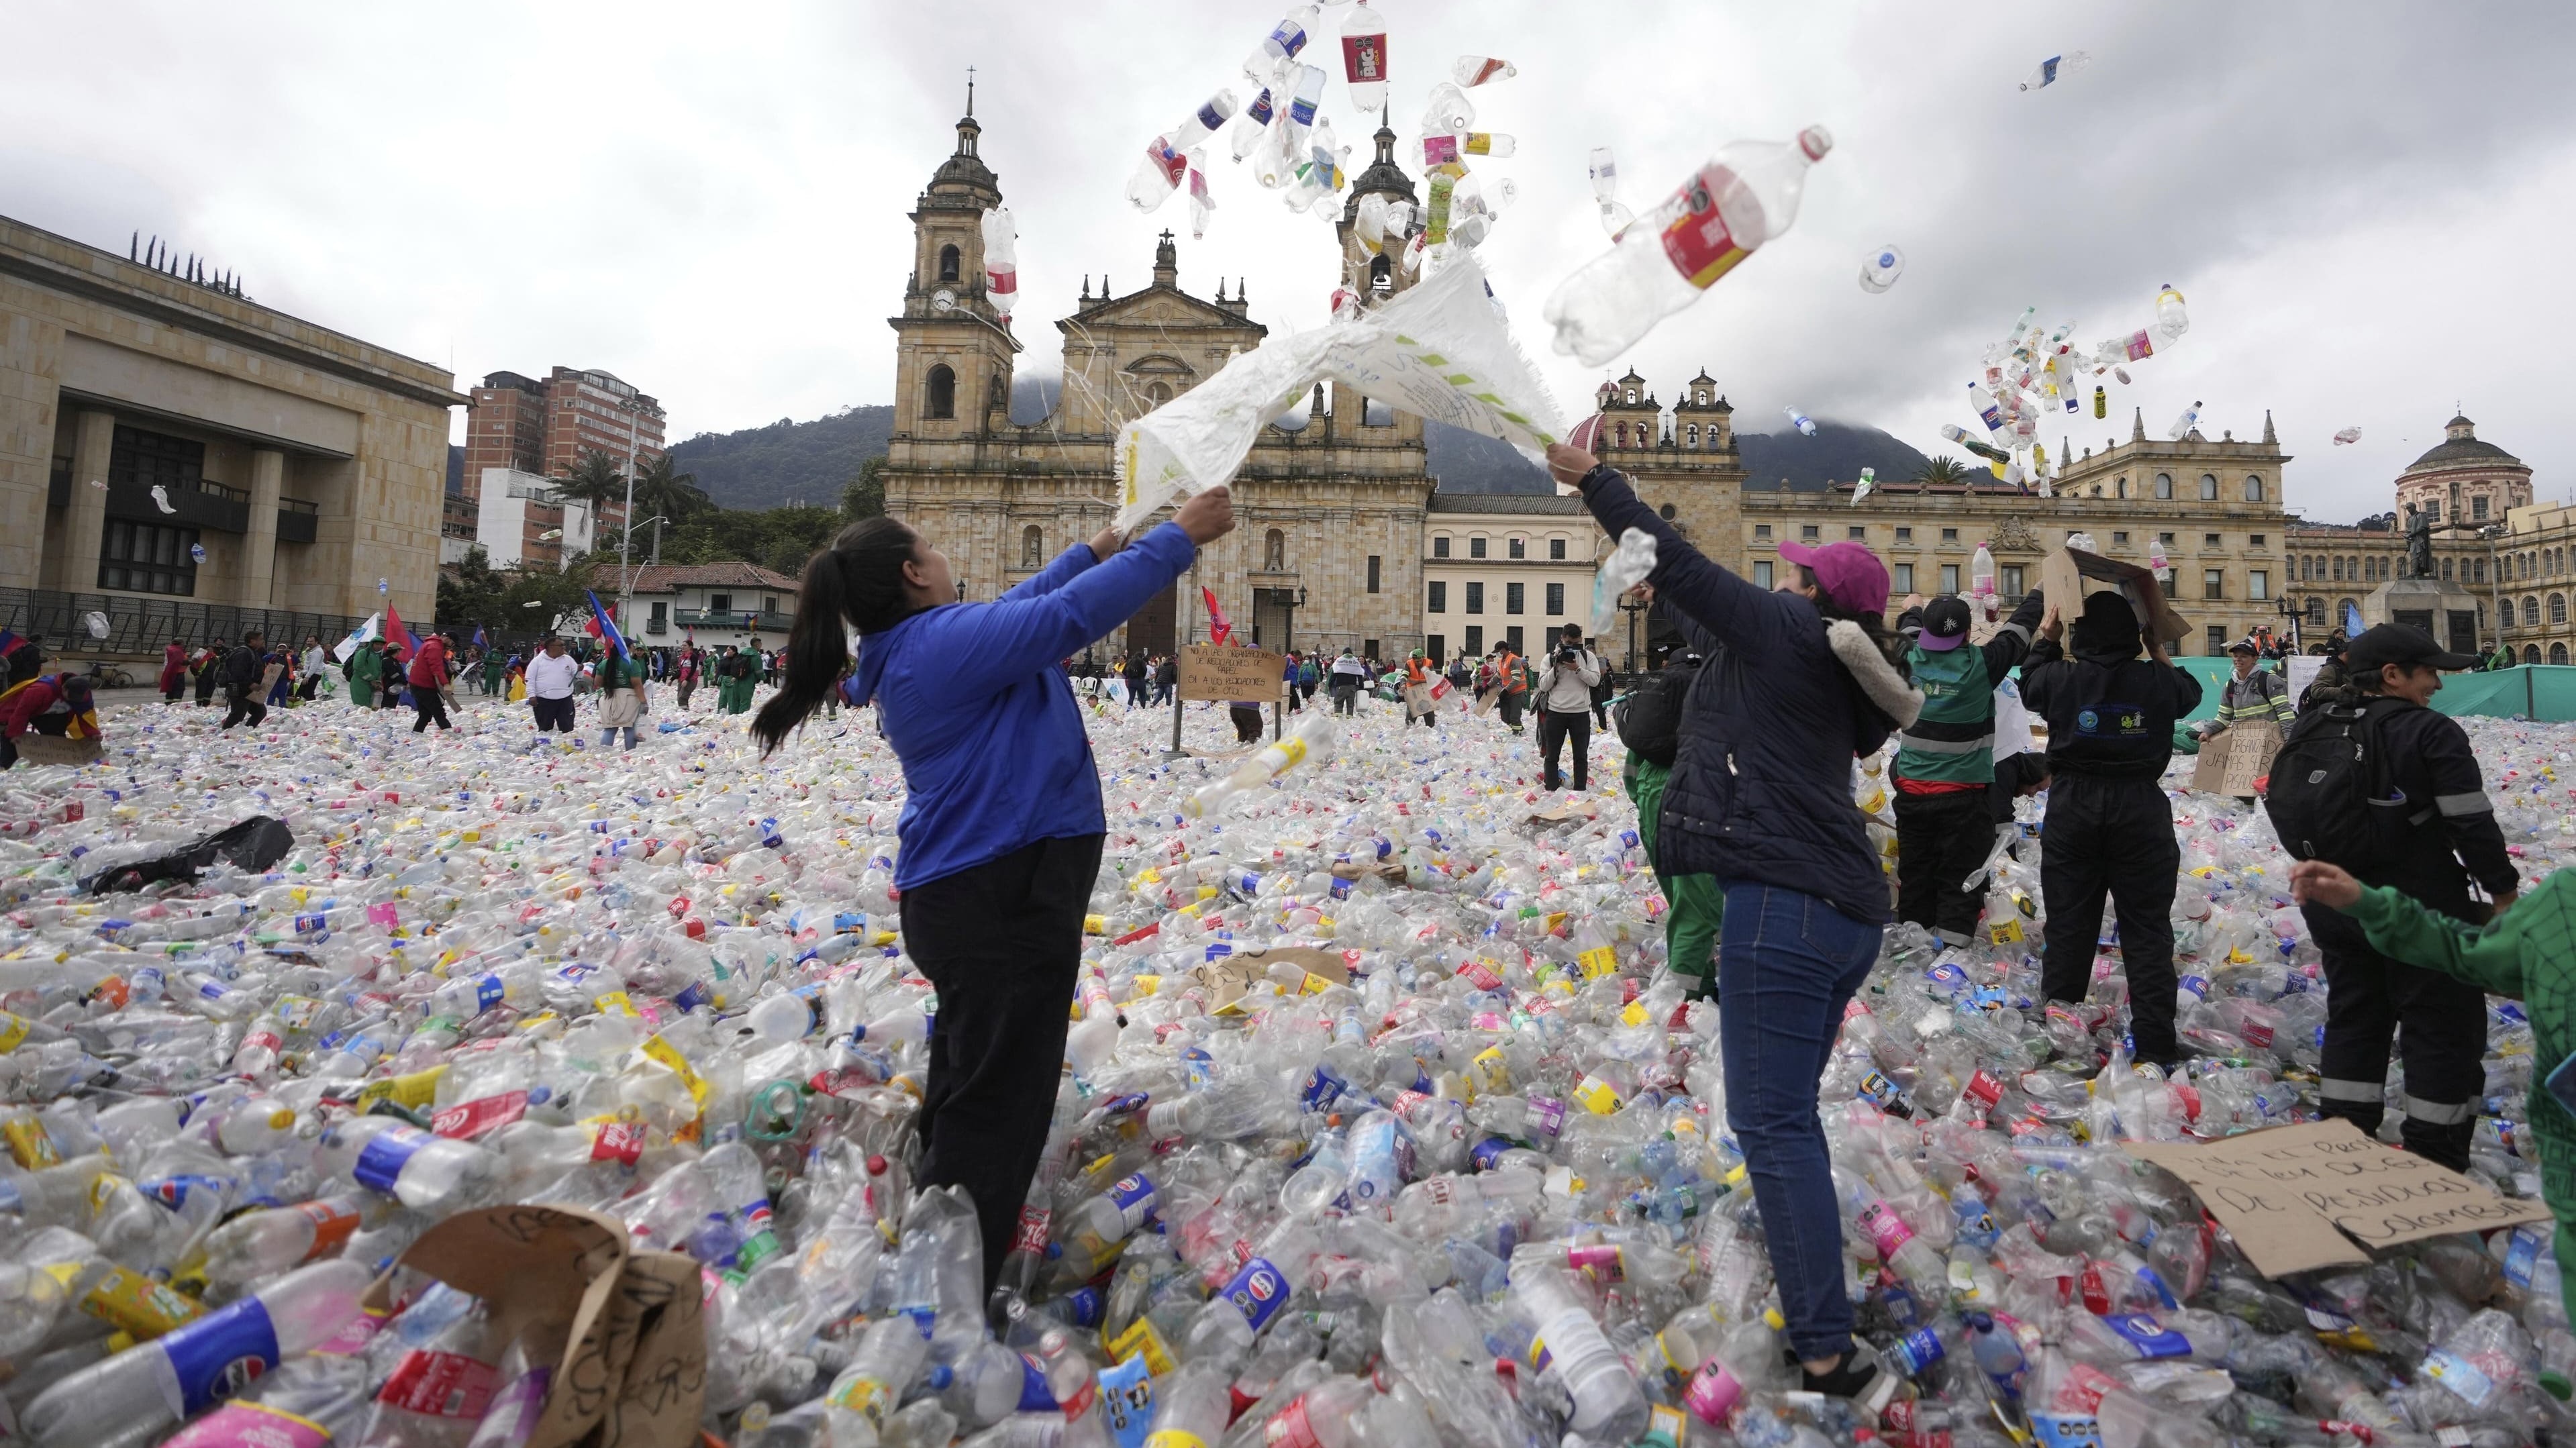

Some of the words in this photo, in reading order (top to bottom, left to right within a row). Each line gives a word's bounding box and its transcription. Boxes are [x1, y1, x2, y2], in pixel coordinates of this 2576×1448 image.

[1360, 48, 1377, 77] BIG
[1203, 676, 1208, 684] A
[1211, 678, 1223, 686] LOS
[2232, 723, 2285, 742] RECICLADO
[2206, 753, 2244, 770] JAMAS
[1254, 1275, 1272, 1296] PEPSI
